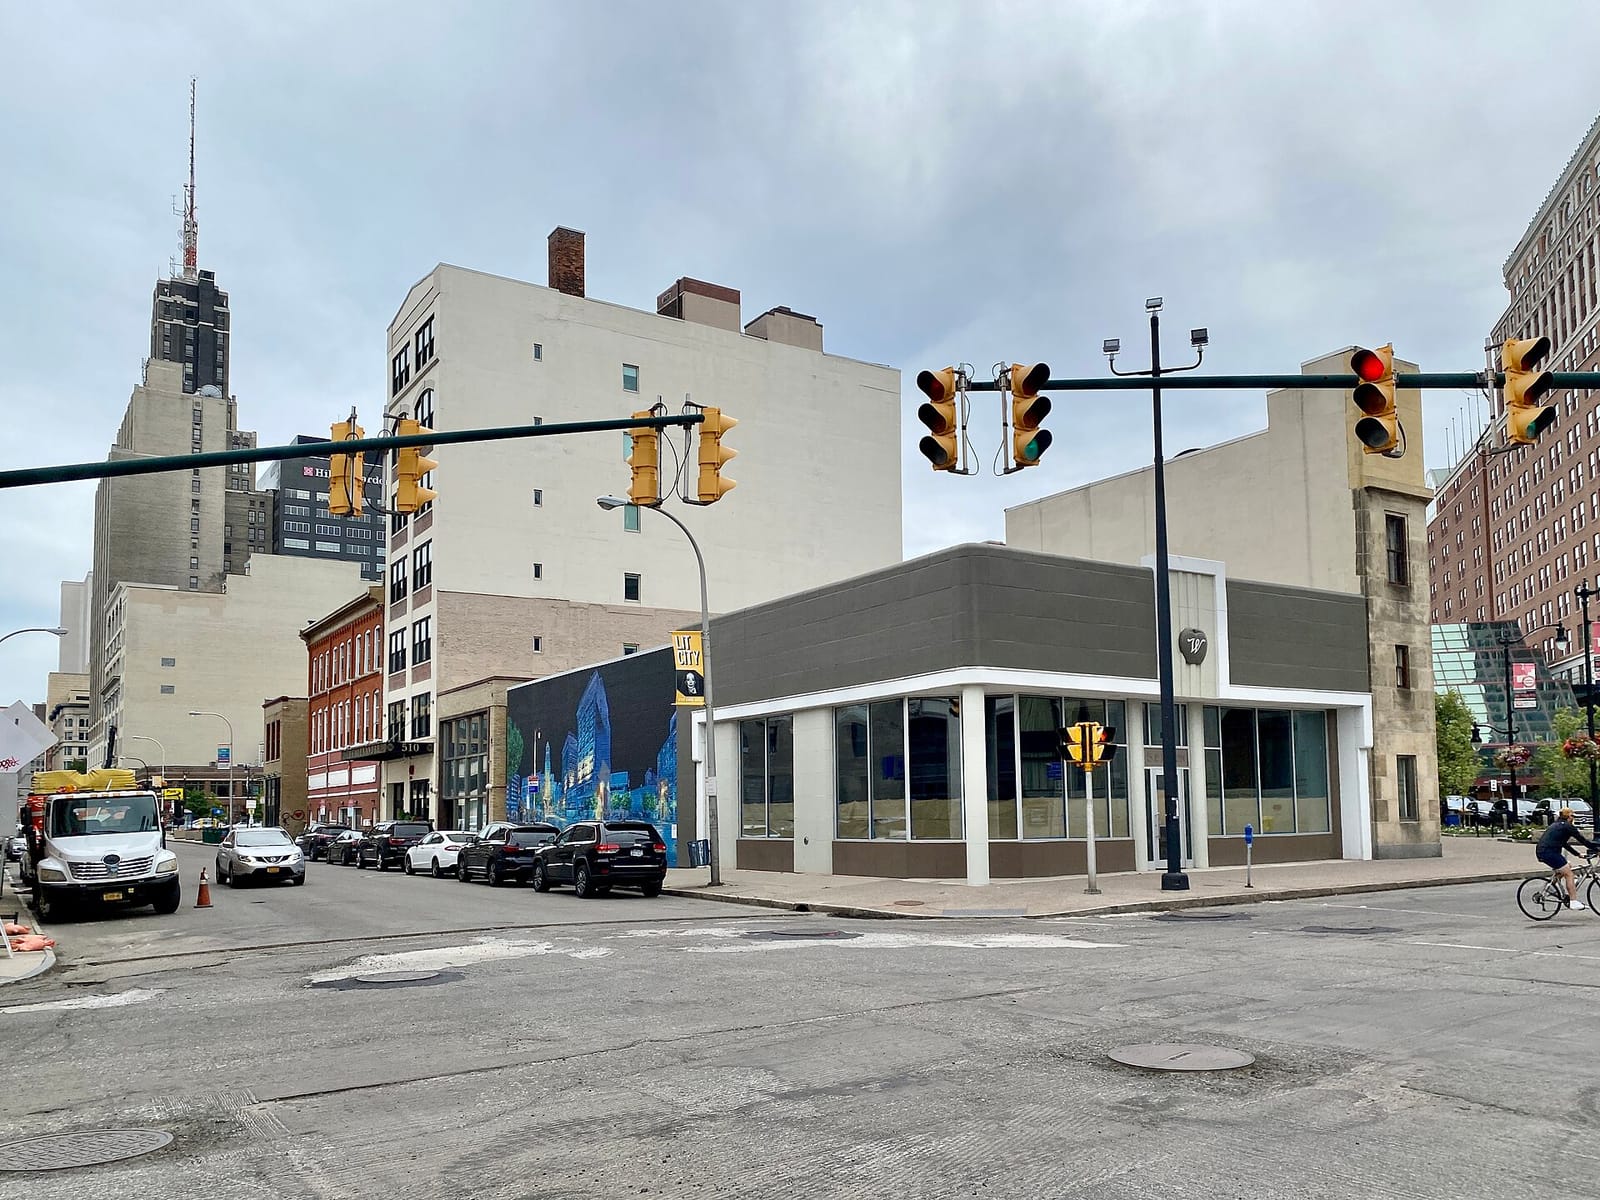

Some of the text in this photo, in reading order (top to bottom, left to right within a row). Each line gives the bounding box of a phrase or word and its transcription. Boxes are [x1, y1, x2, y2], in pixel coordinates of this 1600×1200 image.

[675, 635, 691, 651] LIT
[677, 650, 700, 666] CITY
[401, 743, 419, 752] 510
